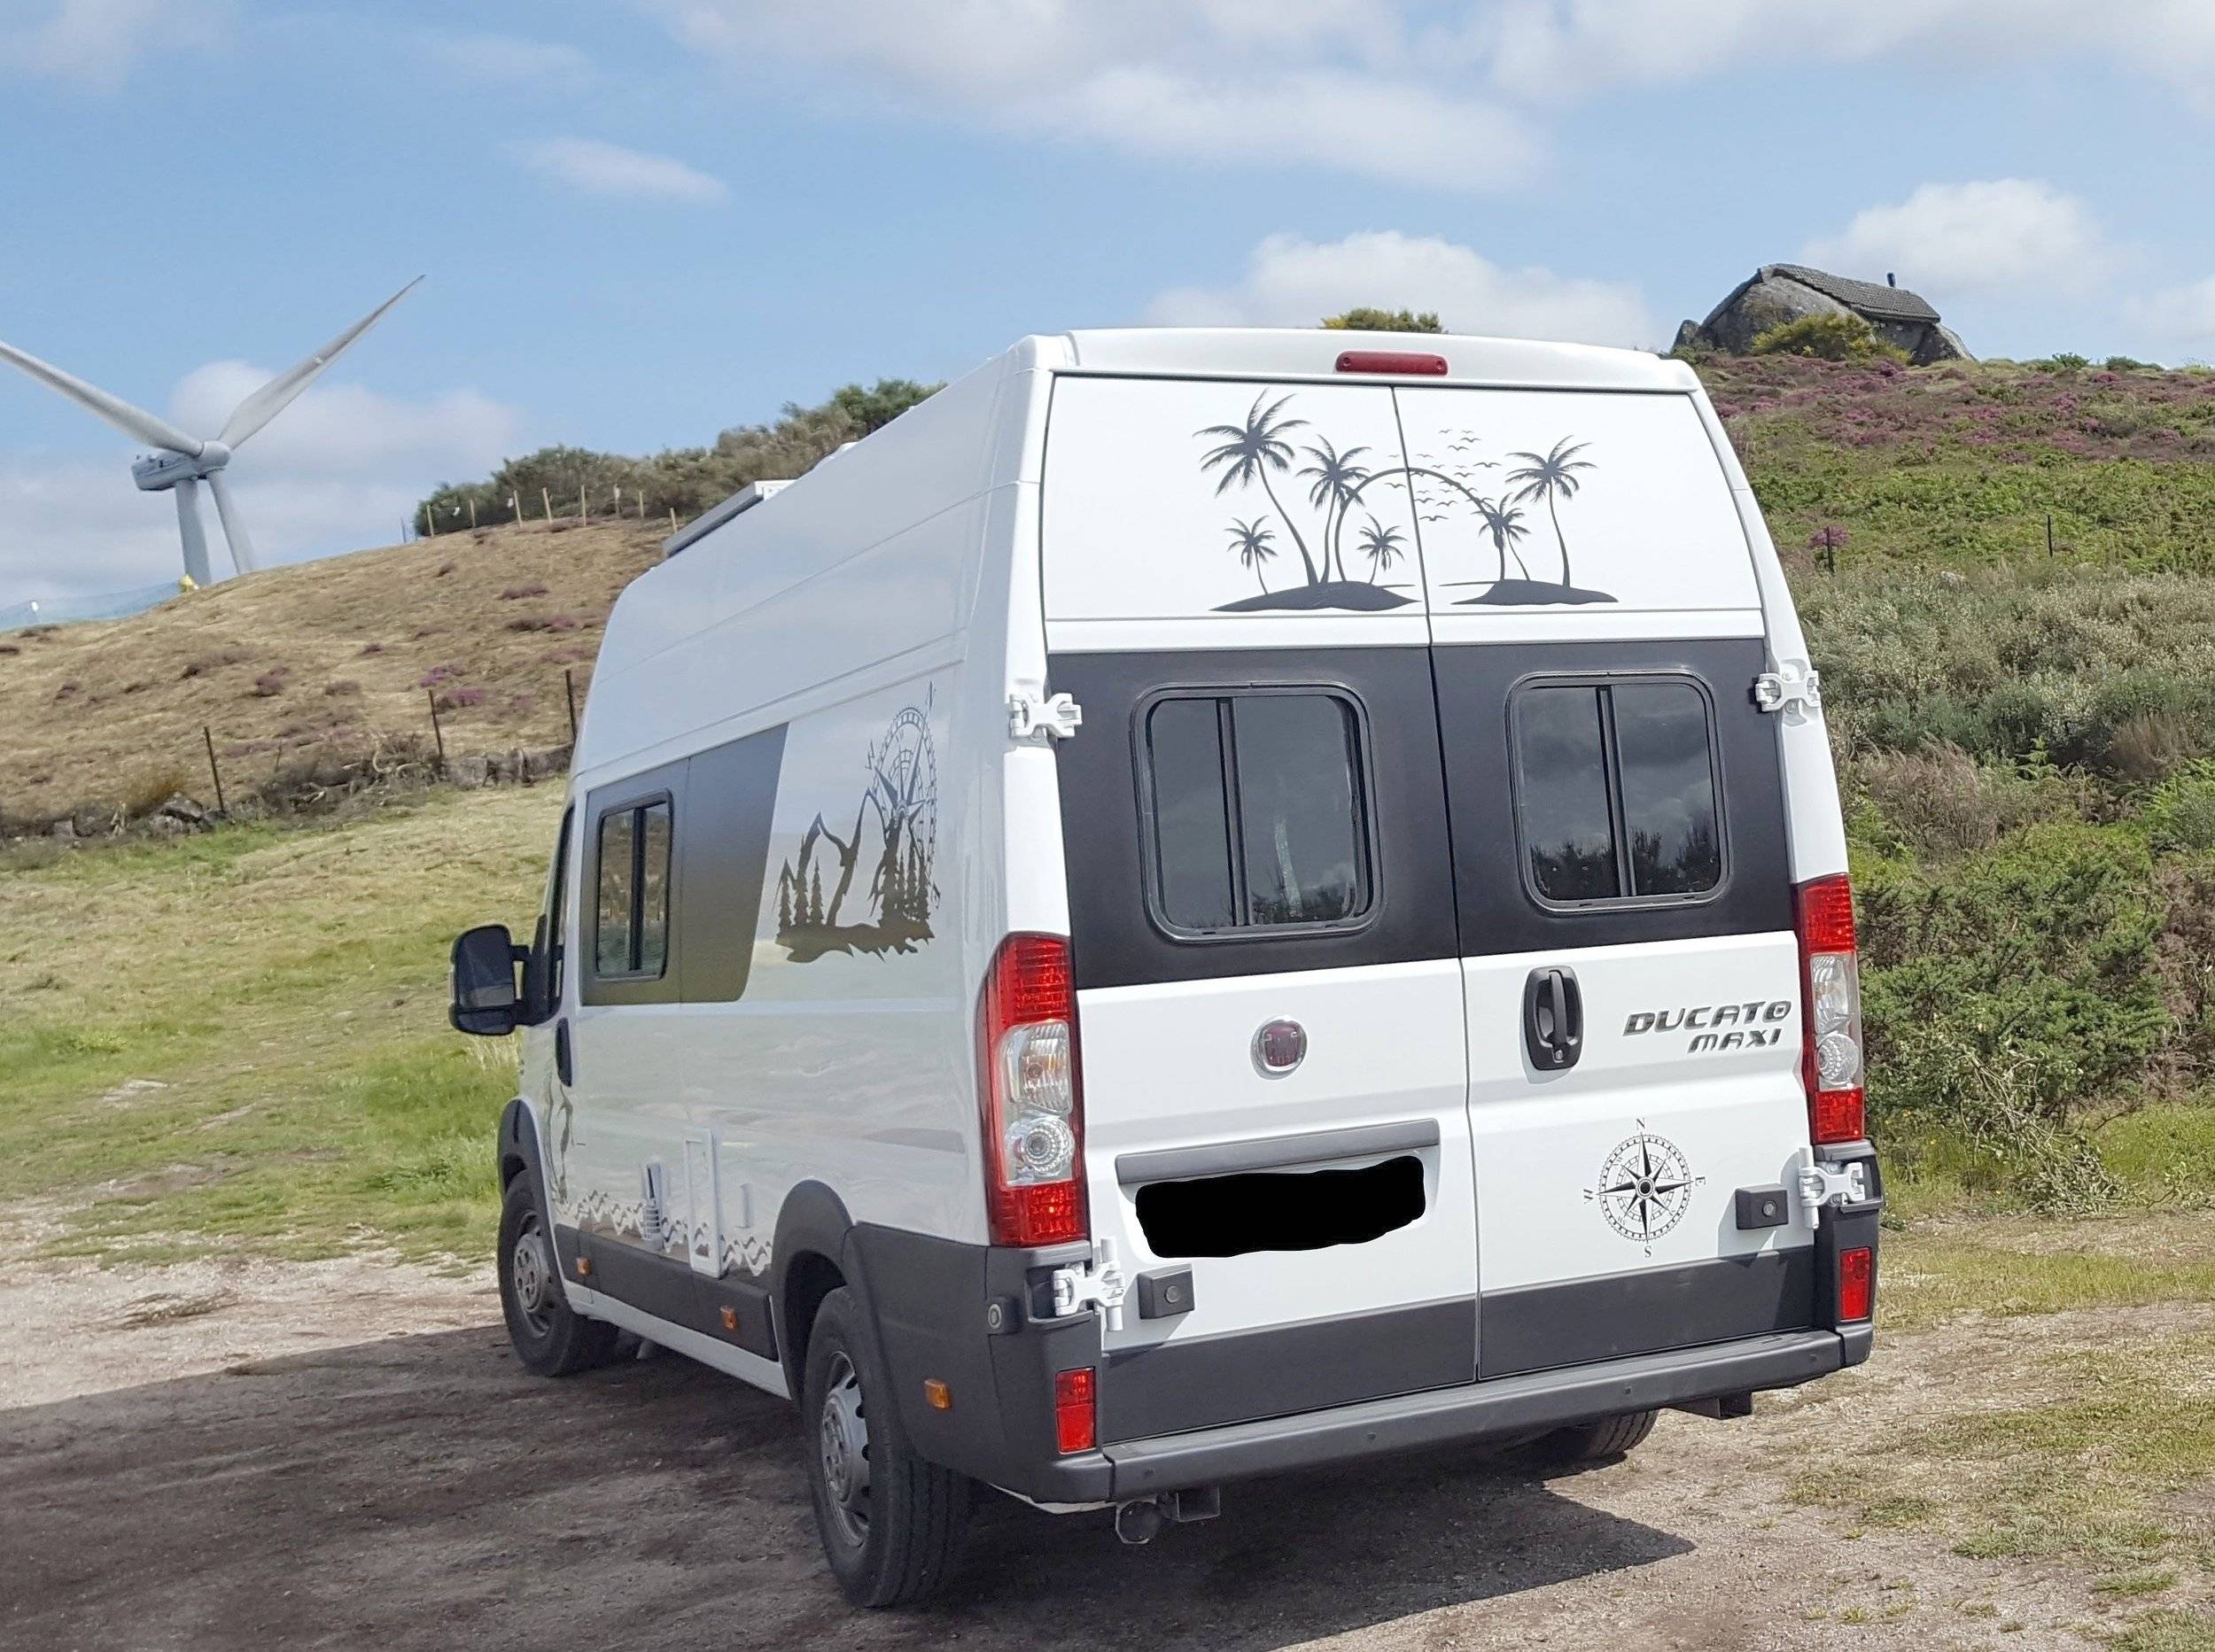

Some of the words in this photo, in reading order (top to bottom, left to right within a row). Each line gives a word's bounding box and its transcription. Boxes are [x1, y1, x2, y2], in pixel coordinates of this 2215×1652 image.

[1624, 1001, 1791, 1035] DUCATO
[1688, 1028, 1782, 1053] MAXI
[1636, 1117, 1645, 1130] N
[1695, 1176, 1706, 1187] E
[1644, 1245, 1652, 1258] S
